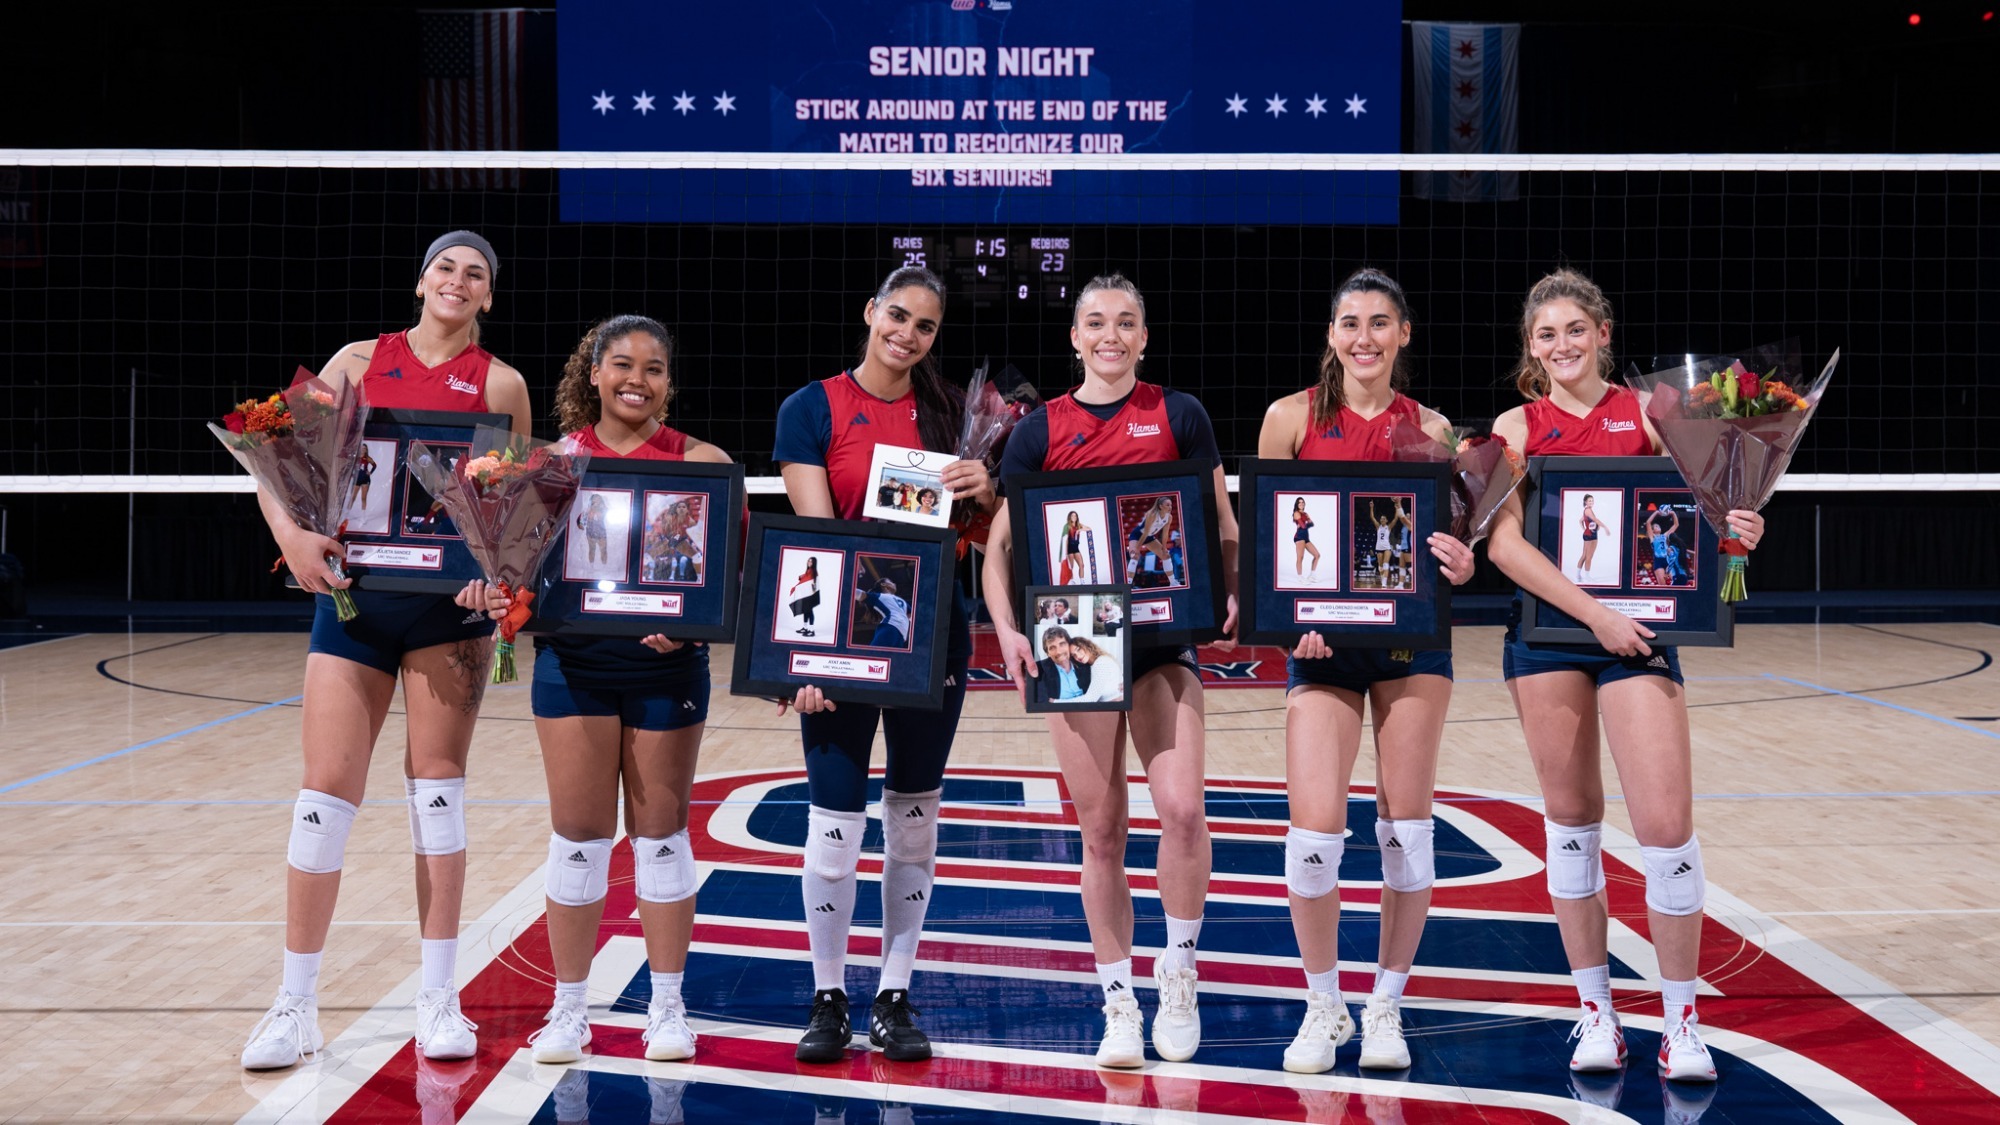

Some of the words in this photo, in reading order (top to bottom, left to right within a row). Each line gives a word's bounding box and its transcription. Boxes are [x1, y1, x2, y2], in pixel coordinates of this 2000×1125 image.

[869, 46, 987, 76] SENIOR
[997, 47, 1095, 76] NIGHT
[795, 99, 859, 121] STICK
[866, 99, 955, 121] AROUND
[961, 100, 988, 121] AT
[994, 100, 1035, 121] THE
[1042, 100, 1085, 121] END
[1092, 101, 1119, 121] OF
[1125, 101, 1168, 121] THE
[839, 133, 914, 153] MATCH
[920, 133, 948, 153] TO
[954, 133, 1073, 153] RECOGNIZE
[1079, 133, 1124, 153] OUR
[911, 168, 947, 187] SIX
[953, 168, 1053, 187] SENIORS!
[892, 237, 923, 249] FLAMES
[975, 238, 1006, 258] 1:15
[1030, 238, 1070, 250] REDBIRDS
[977, 264, 987, 277] 4
[1040, 252, 1065, 272] 23
[1017, 284, 1028, 300] 0
[445, 374, 478, 394] Flames
[1126, 423, 1160, 437] Flames
[1601, 418, 1636, 432] Flames
[1659, 541, 1665, 550] 3
